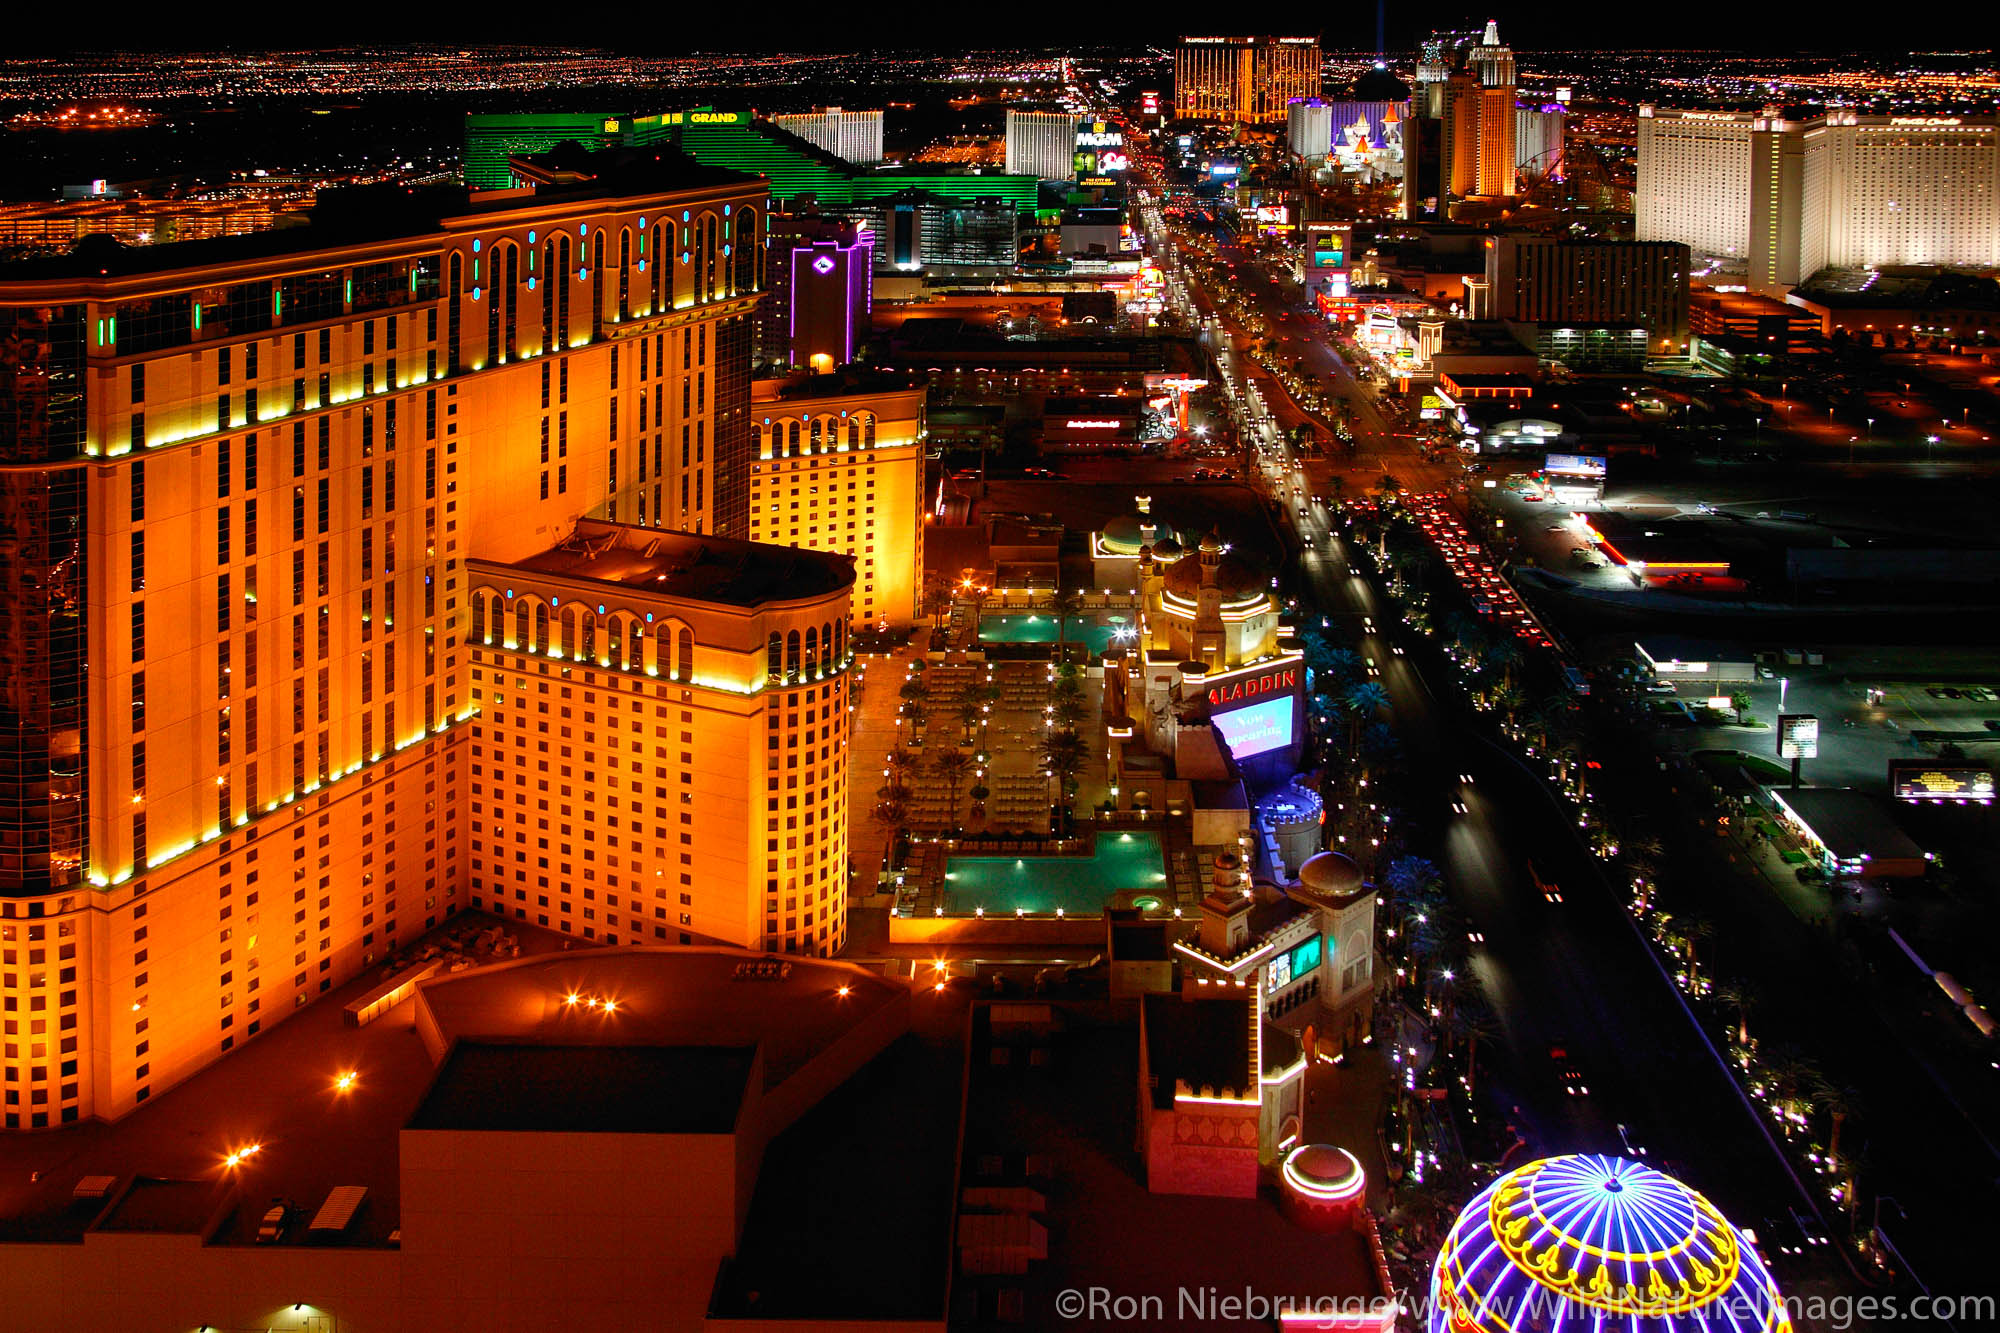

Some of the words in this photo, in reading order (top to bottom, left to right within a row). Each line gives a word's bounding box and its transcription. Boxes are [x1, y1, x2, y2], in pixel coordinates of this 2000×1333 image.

[691, 113, 737, 122] GRAND
[1076, 133, 1123, 146] MGM
[1209, 670, 1296, 704] ALADDIN
[1237, 714, 1264, 727] Now
